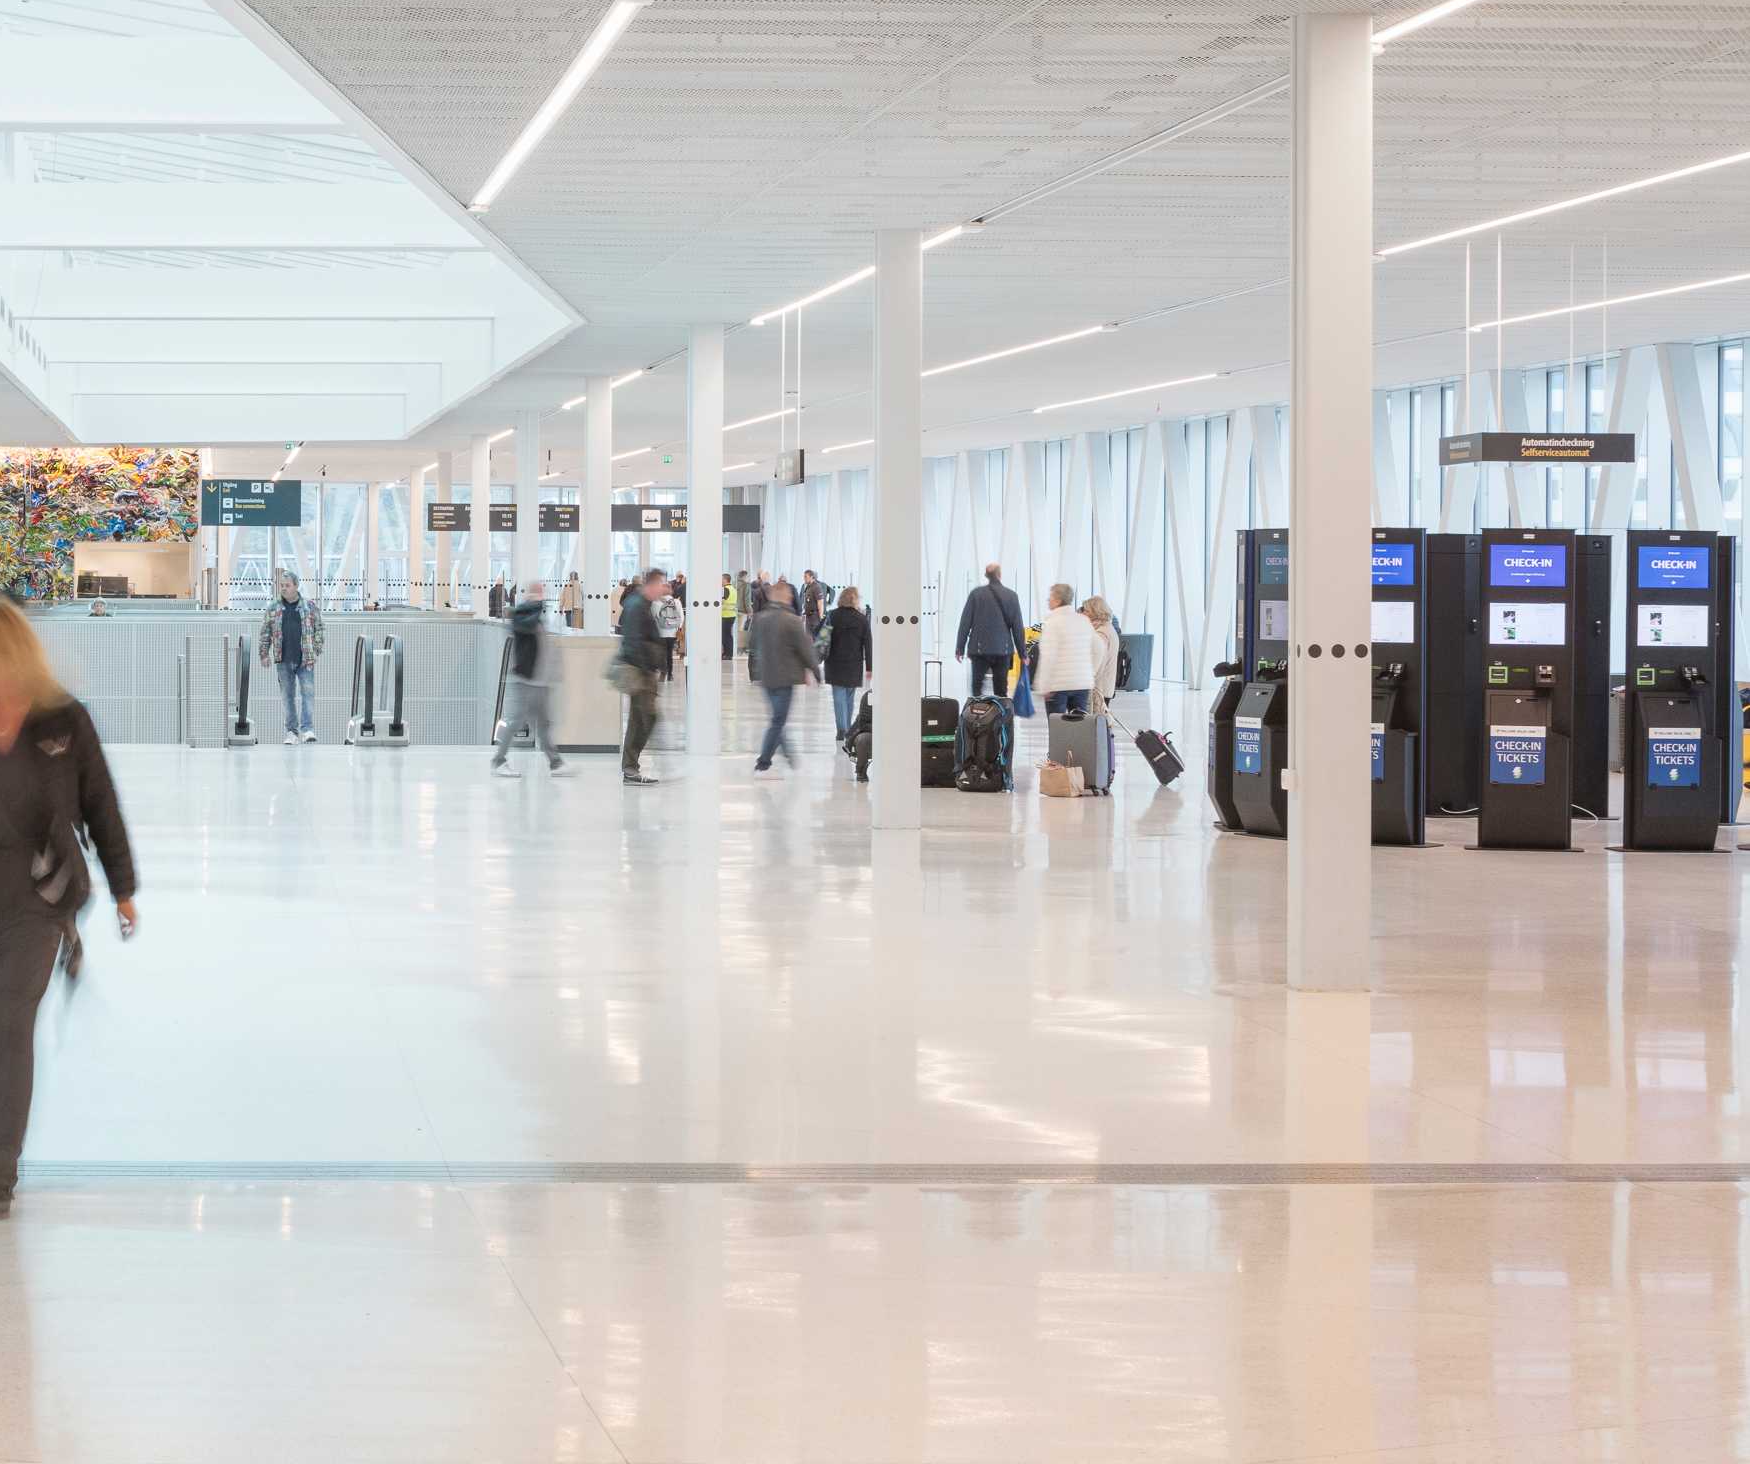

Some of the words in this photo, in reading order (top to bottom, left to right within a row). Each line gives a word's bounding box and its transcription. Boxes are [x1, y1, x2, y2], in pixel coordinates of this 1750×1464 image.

[1522, 438, 1594, 448] Automatincheckning
[1521, 448, 1591, 457] Selfserviceautomat
[670, 509, 682, 518] Till
[670, 519, 679, 528] To
[1372, 557, 1403, 567] ECK-IN
[1503, 558, 1553, 568] CHECK-IN
[1650, 560, 1697, 569] CHECK-IN
[1237, 731, 1260, 742] CHECK-IN
[1238, 743, 1259, 754] TICKETS
[1494, 740, 1542, 751] CHECK-IN
[1652, 743, 1697, 754] CHECK-IN
[1497, 753, 1539, 764] TICKETS
[1654, 755, 1695, 765] TICKETS
